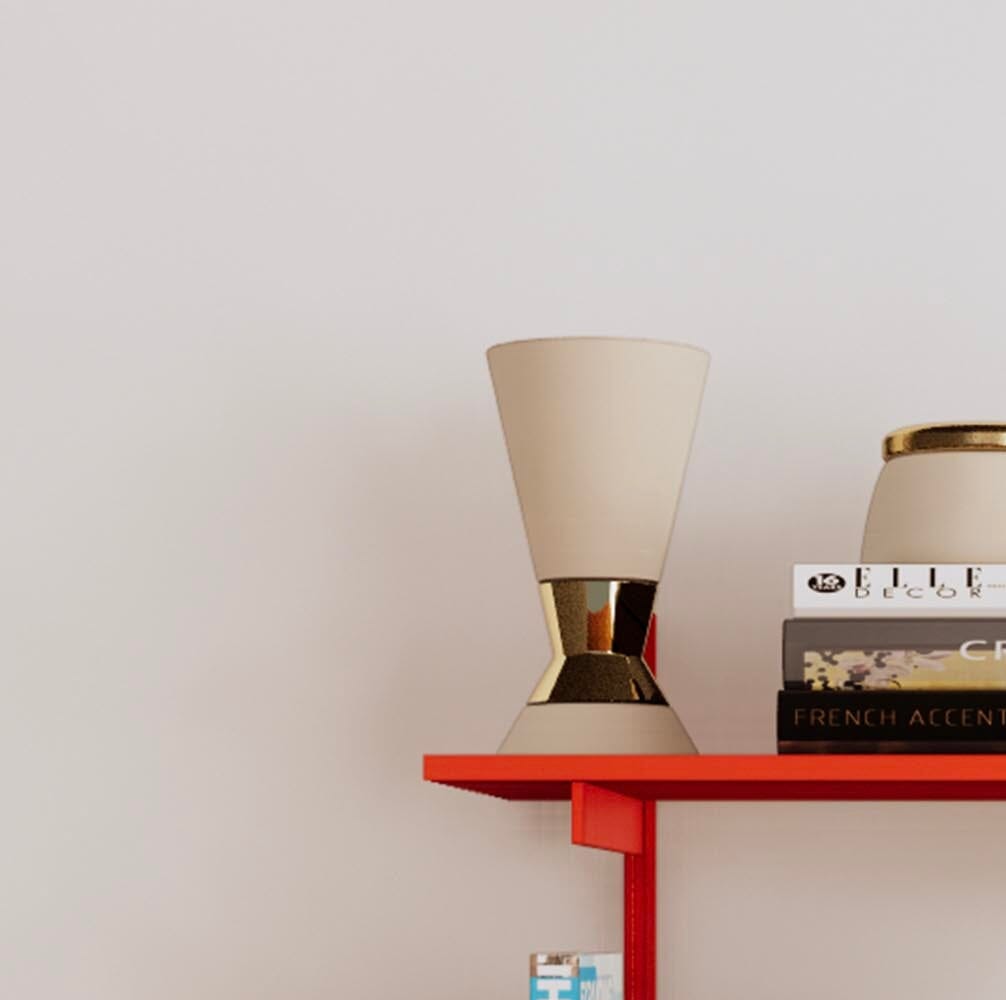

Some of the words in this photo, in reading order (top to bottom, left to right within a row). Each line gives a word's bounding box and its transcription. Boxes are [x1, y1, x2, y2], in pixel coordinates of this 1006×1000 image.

[856, 567, 982, 588] ELLE
[855, 588, 982, 599] DECOR
[794, 708, 897, 727] FRENCH
